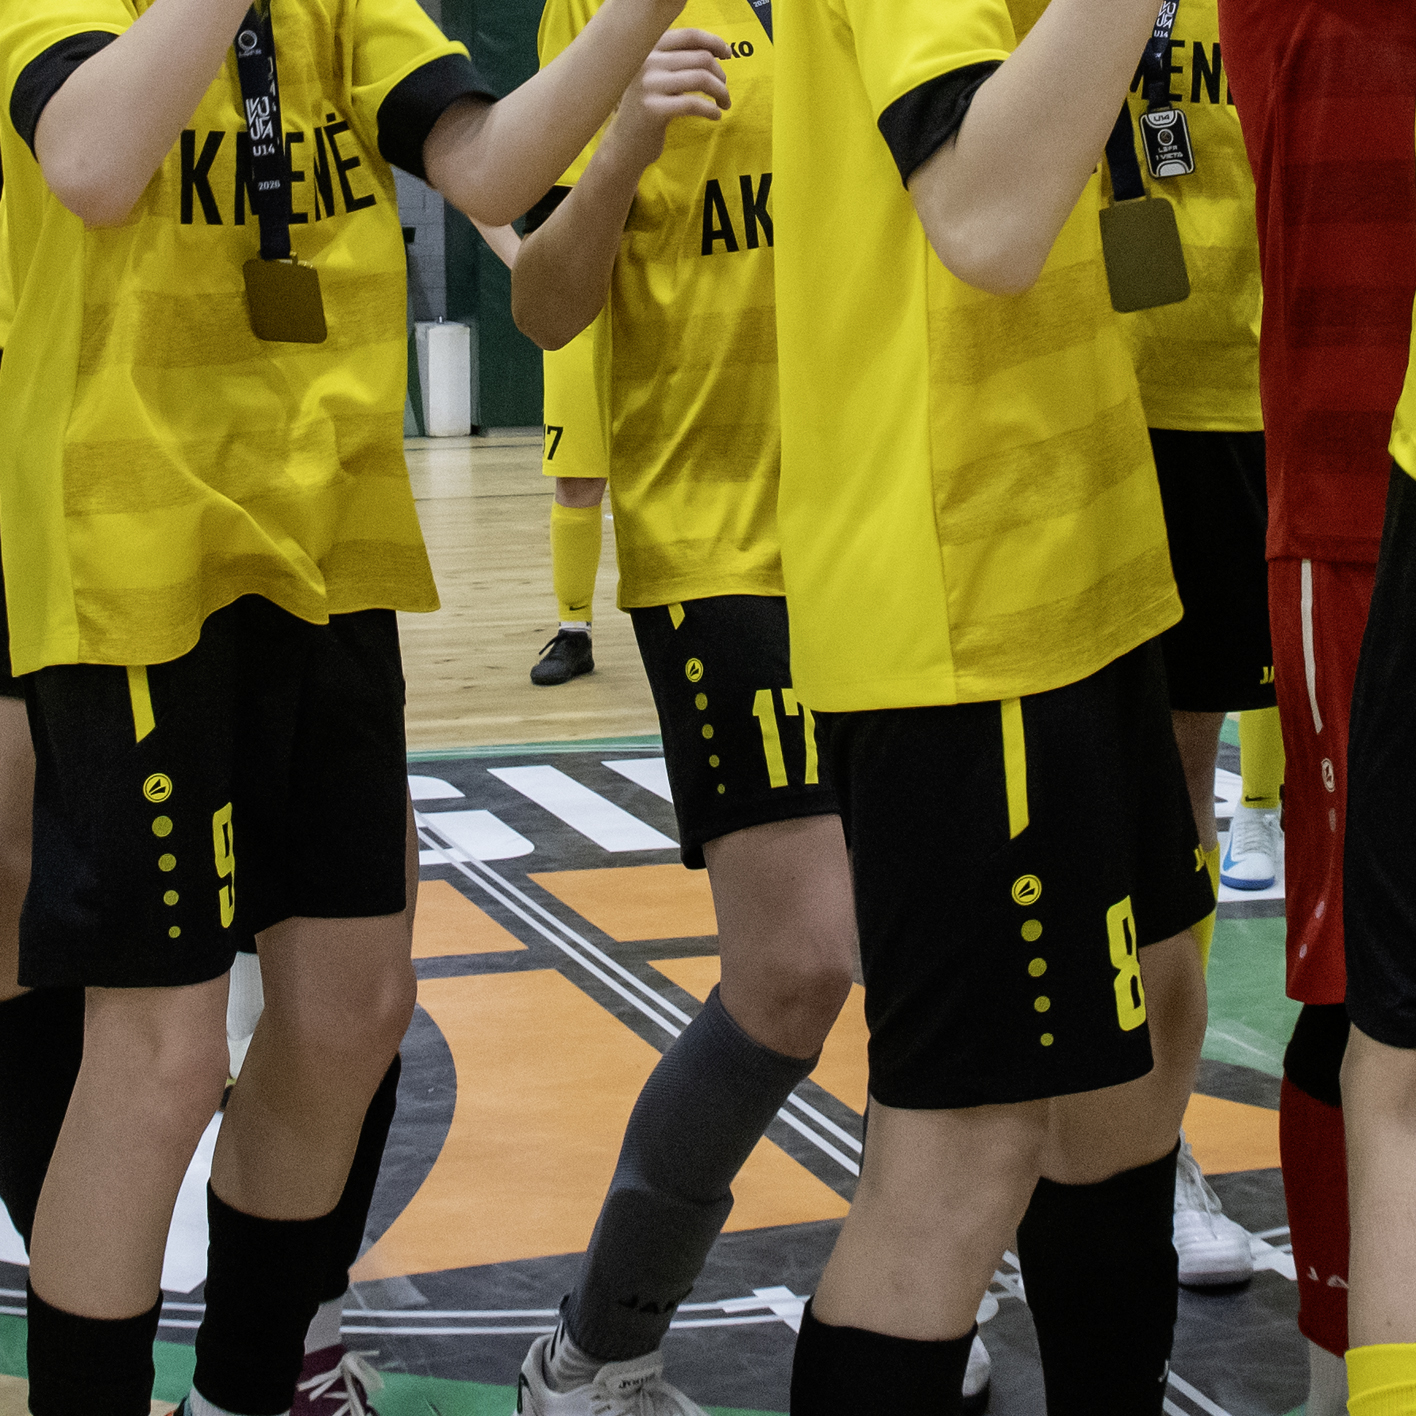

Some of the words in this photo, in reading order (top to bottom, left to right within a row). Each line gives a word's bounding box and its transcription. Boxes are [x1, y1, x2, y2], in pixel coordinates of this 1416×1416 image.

[1153, 114, 1170, 122] U14
[253, 144, 275, 156] U14
[752, 687, 821, 789] 17
[1106, 895, 1147, 1032] 8
